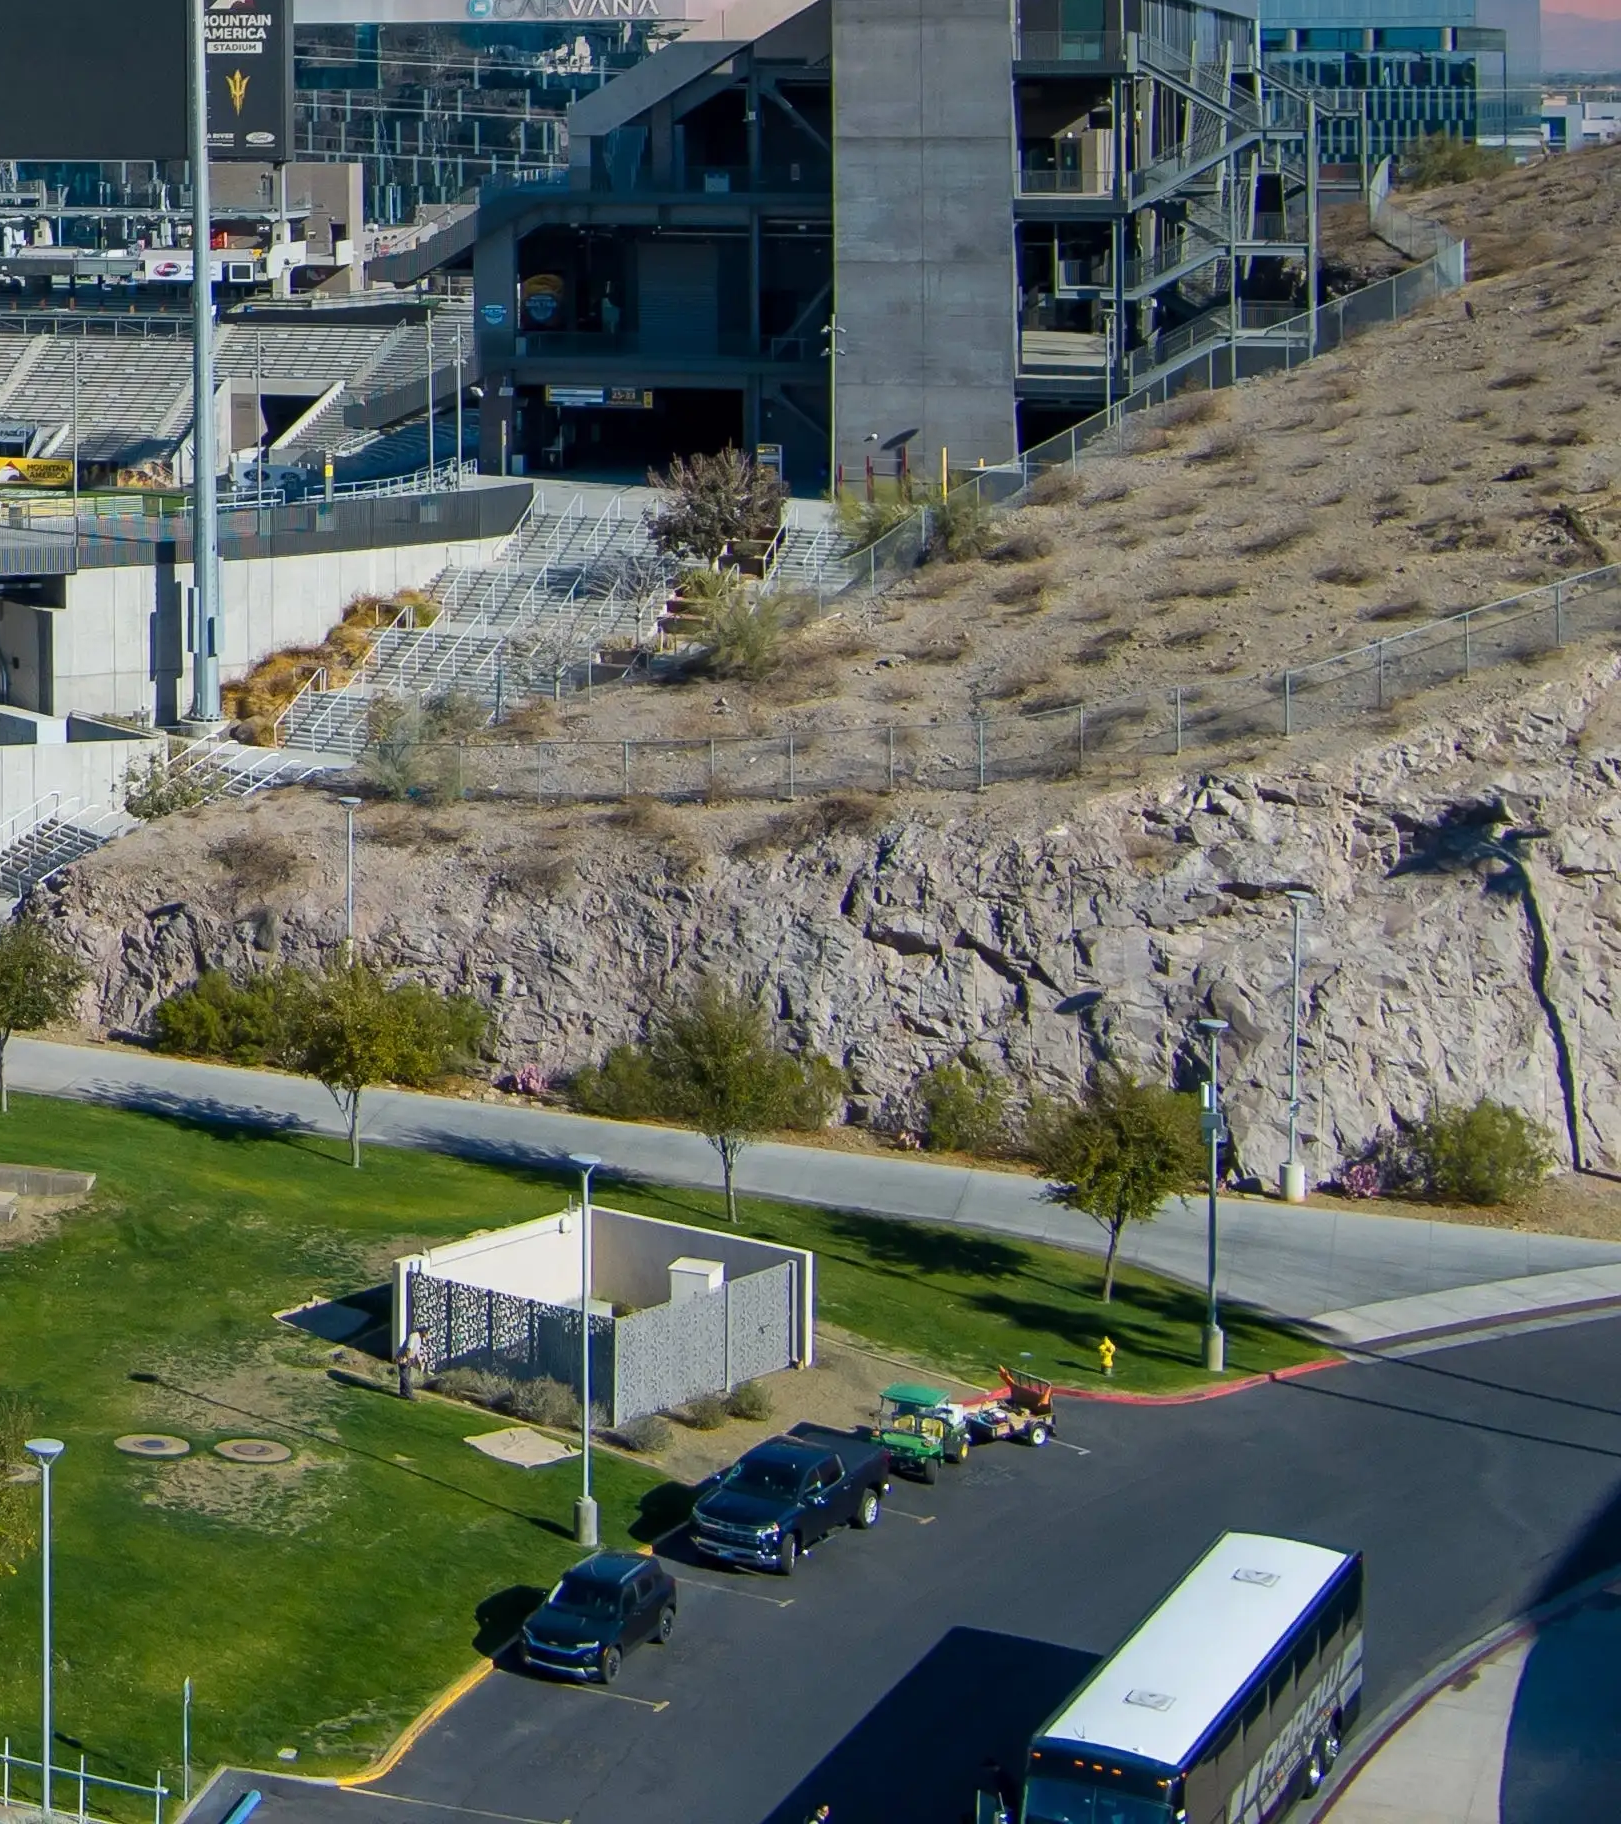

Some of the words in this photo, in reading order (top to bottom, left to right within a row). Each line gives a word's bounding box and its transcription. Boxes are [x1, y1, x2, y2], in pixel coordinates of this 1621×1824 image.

[203, 27, 267, 39] AMERICA
[213, 43, 257, 52] STADIUM
[26, 463, 69, 472] MOUNTAIN
[29, 471, 67, 480] AMERICA
